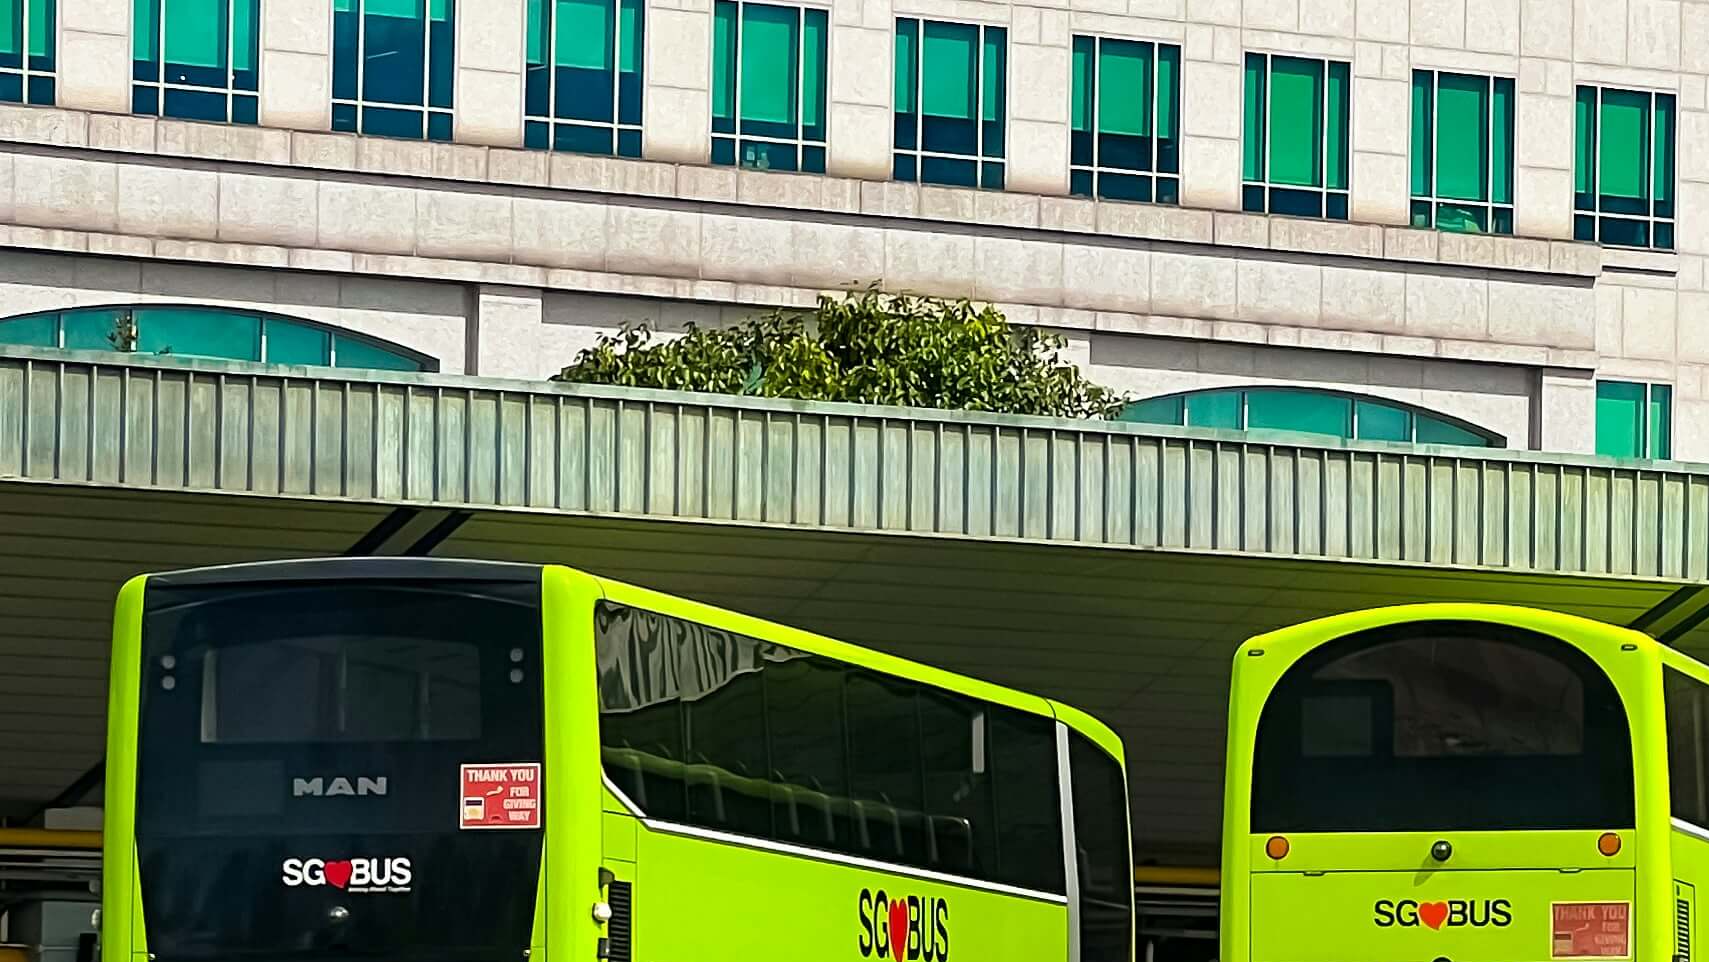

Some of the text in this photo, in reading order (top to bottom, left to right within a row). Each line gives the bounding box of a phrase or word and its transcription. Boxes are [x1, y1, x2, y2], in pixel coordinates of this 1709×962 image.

[467, 769, 534, 782] THANK YOU
[294, 777, 387, 796] MAN
